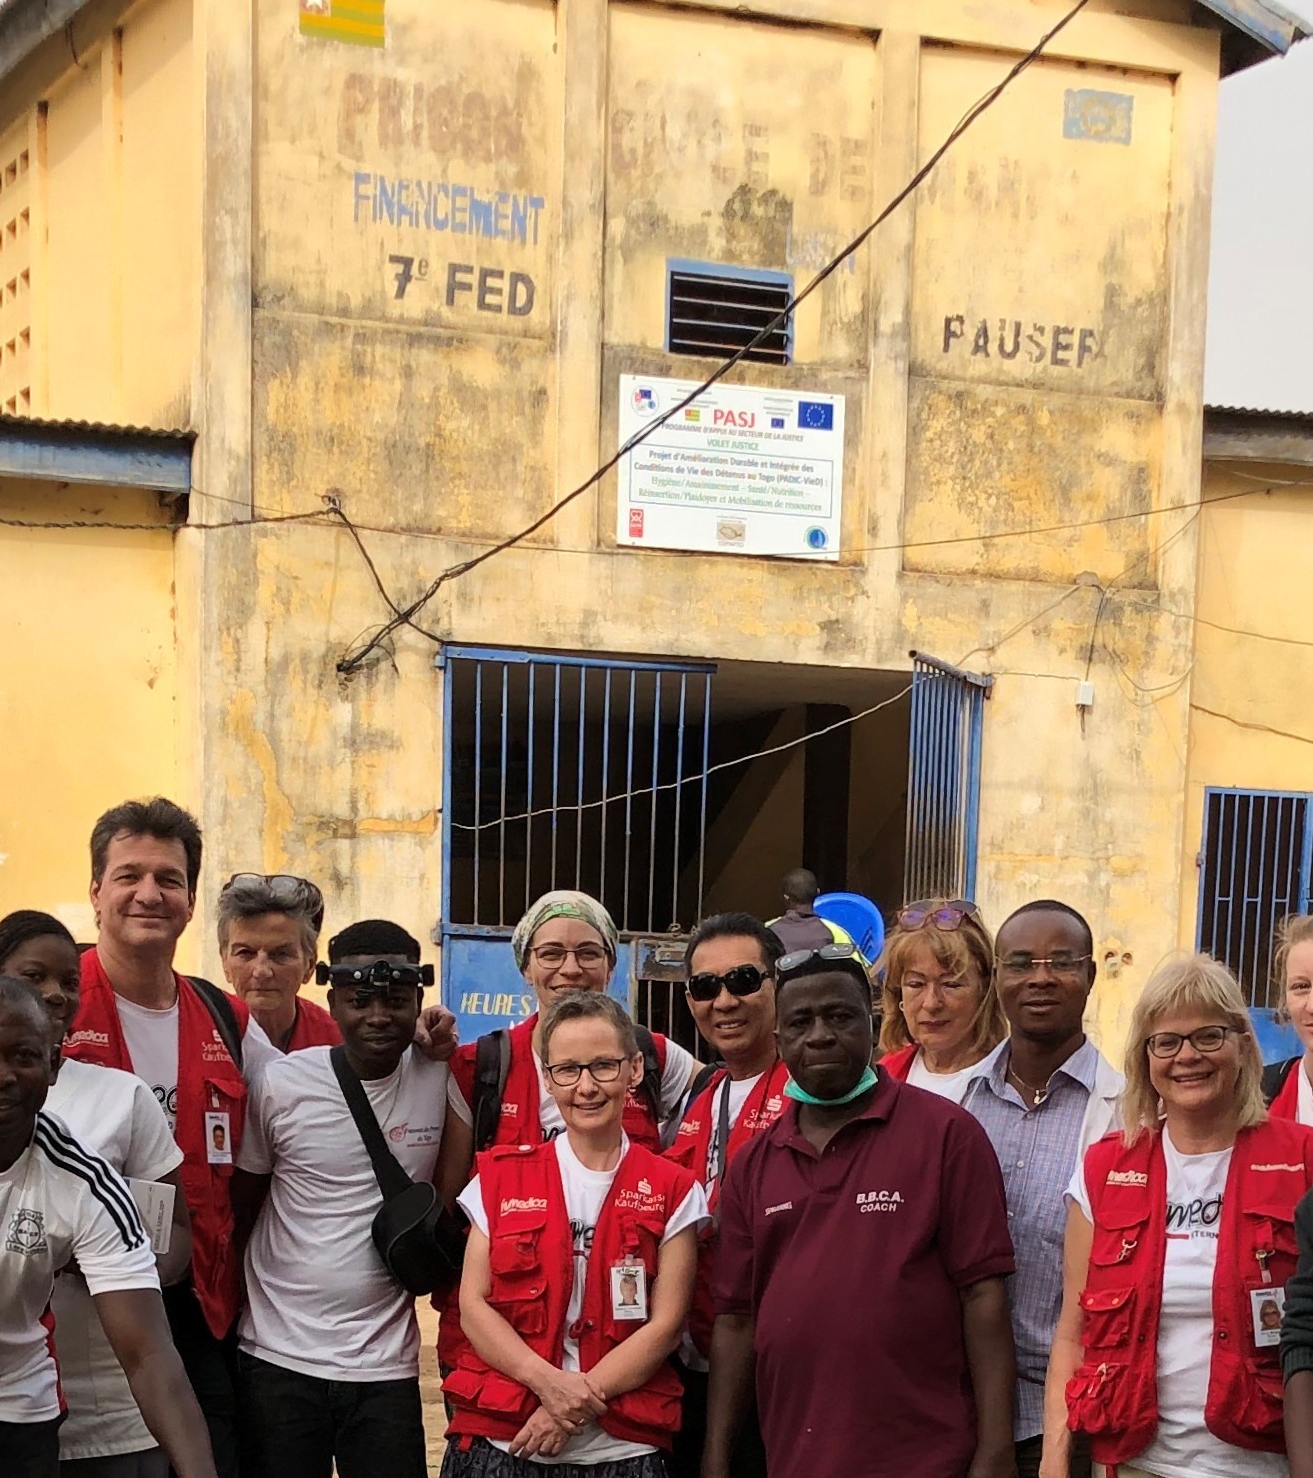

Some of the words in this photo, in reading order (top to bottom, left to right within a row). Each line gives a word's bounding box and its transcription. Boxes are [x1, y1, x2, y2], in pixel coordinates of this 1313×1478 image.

[353, 171, 545, 246] FINANCEMENT
[446, 262, 536, 317] FED
[713, 409, 756, 429] PASJ
[707, 438, 730, 450] VOLET
[731, 440, 759, 451] JUSTICE
[649, 450, 672, 462] Projet
[730, 455, 759, 468] Durable
[801, 462, 814, 473] des
[633, 462, 674, 474] Conditions
[675, 464, 686, 475] de
[687, 465, 699, 477] Vie
[758, 472, 775, 484] Togo
[460, 992, 532, 1016] HEURES
[856, 1190, 904, 1204] B.B.C.A.
[860, 1203, 897, 1213] COACH
